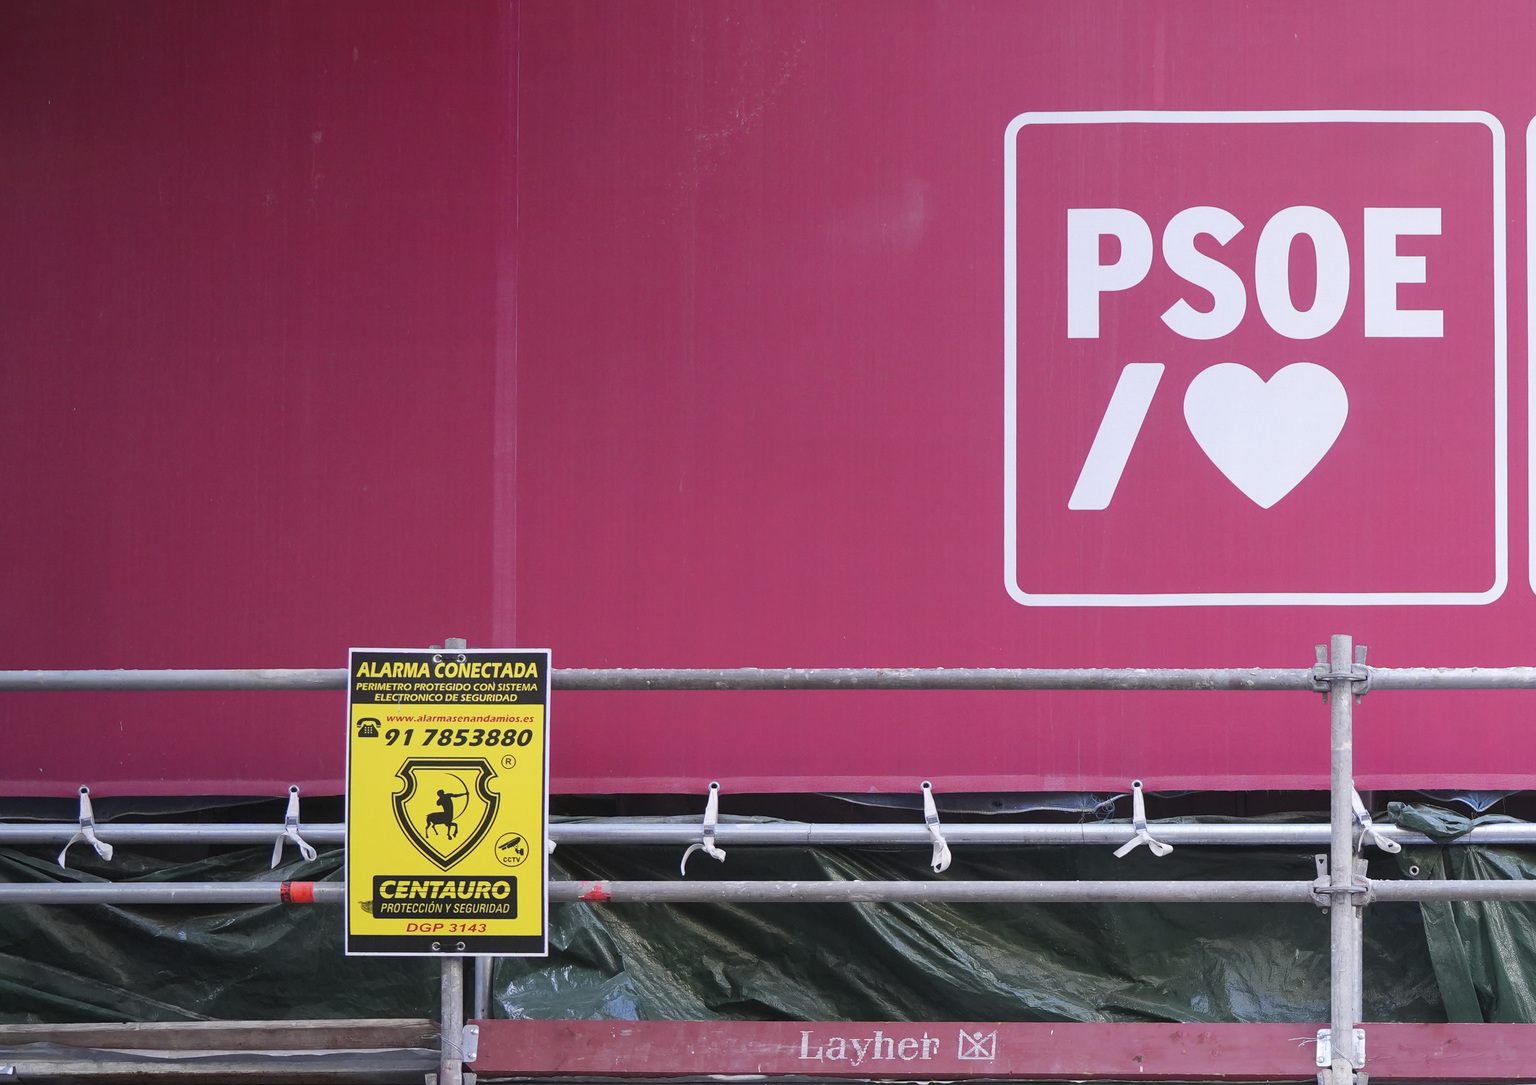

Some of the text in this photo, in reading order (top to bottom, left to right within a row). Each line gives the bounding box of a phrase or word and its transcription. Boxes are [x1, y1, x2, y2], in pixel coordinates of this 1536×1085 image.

[1067, 205, 1444, 340] PSOE
[356, 662, 538, 678] ALARMA CONECTADA
[356, 682, 538, 692] PERIMETRO PROTEGIDO CON SISTEMA
[374, 693, 517, 702] ELECTRONICO DE SEGURIDAD
[386, 714, 534, 723] www.alarmasenandamios.es
[385, 728, 533, 747] 91 7853880
[379, 880, 511, 899] CENTAURO
[380, 901, 510, 914] PROTECCIÓN Y SEGURIDAD
[406, 923, 487, 933] DGP 3143
[798, 1030, 940, 1066] Layher
